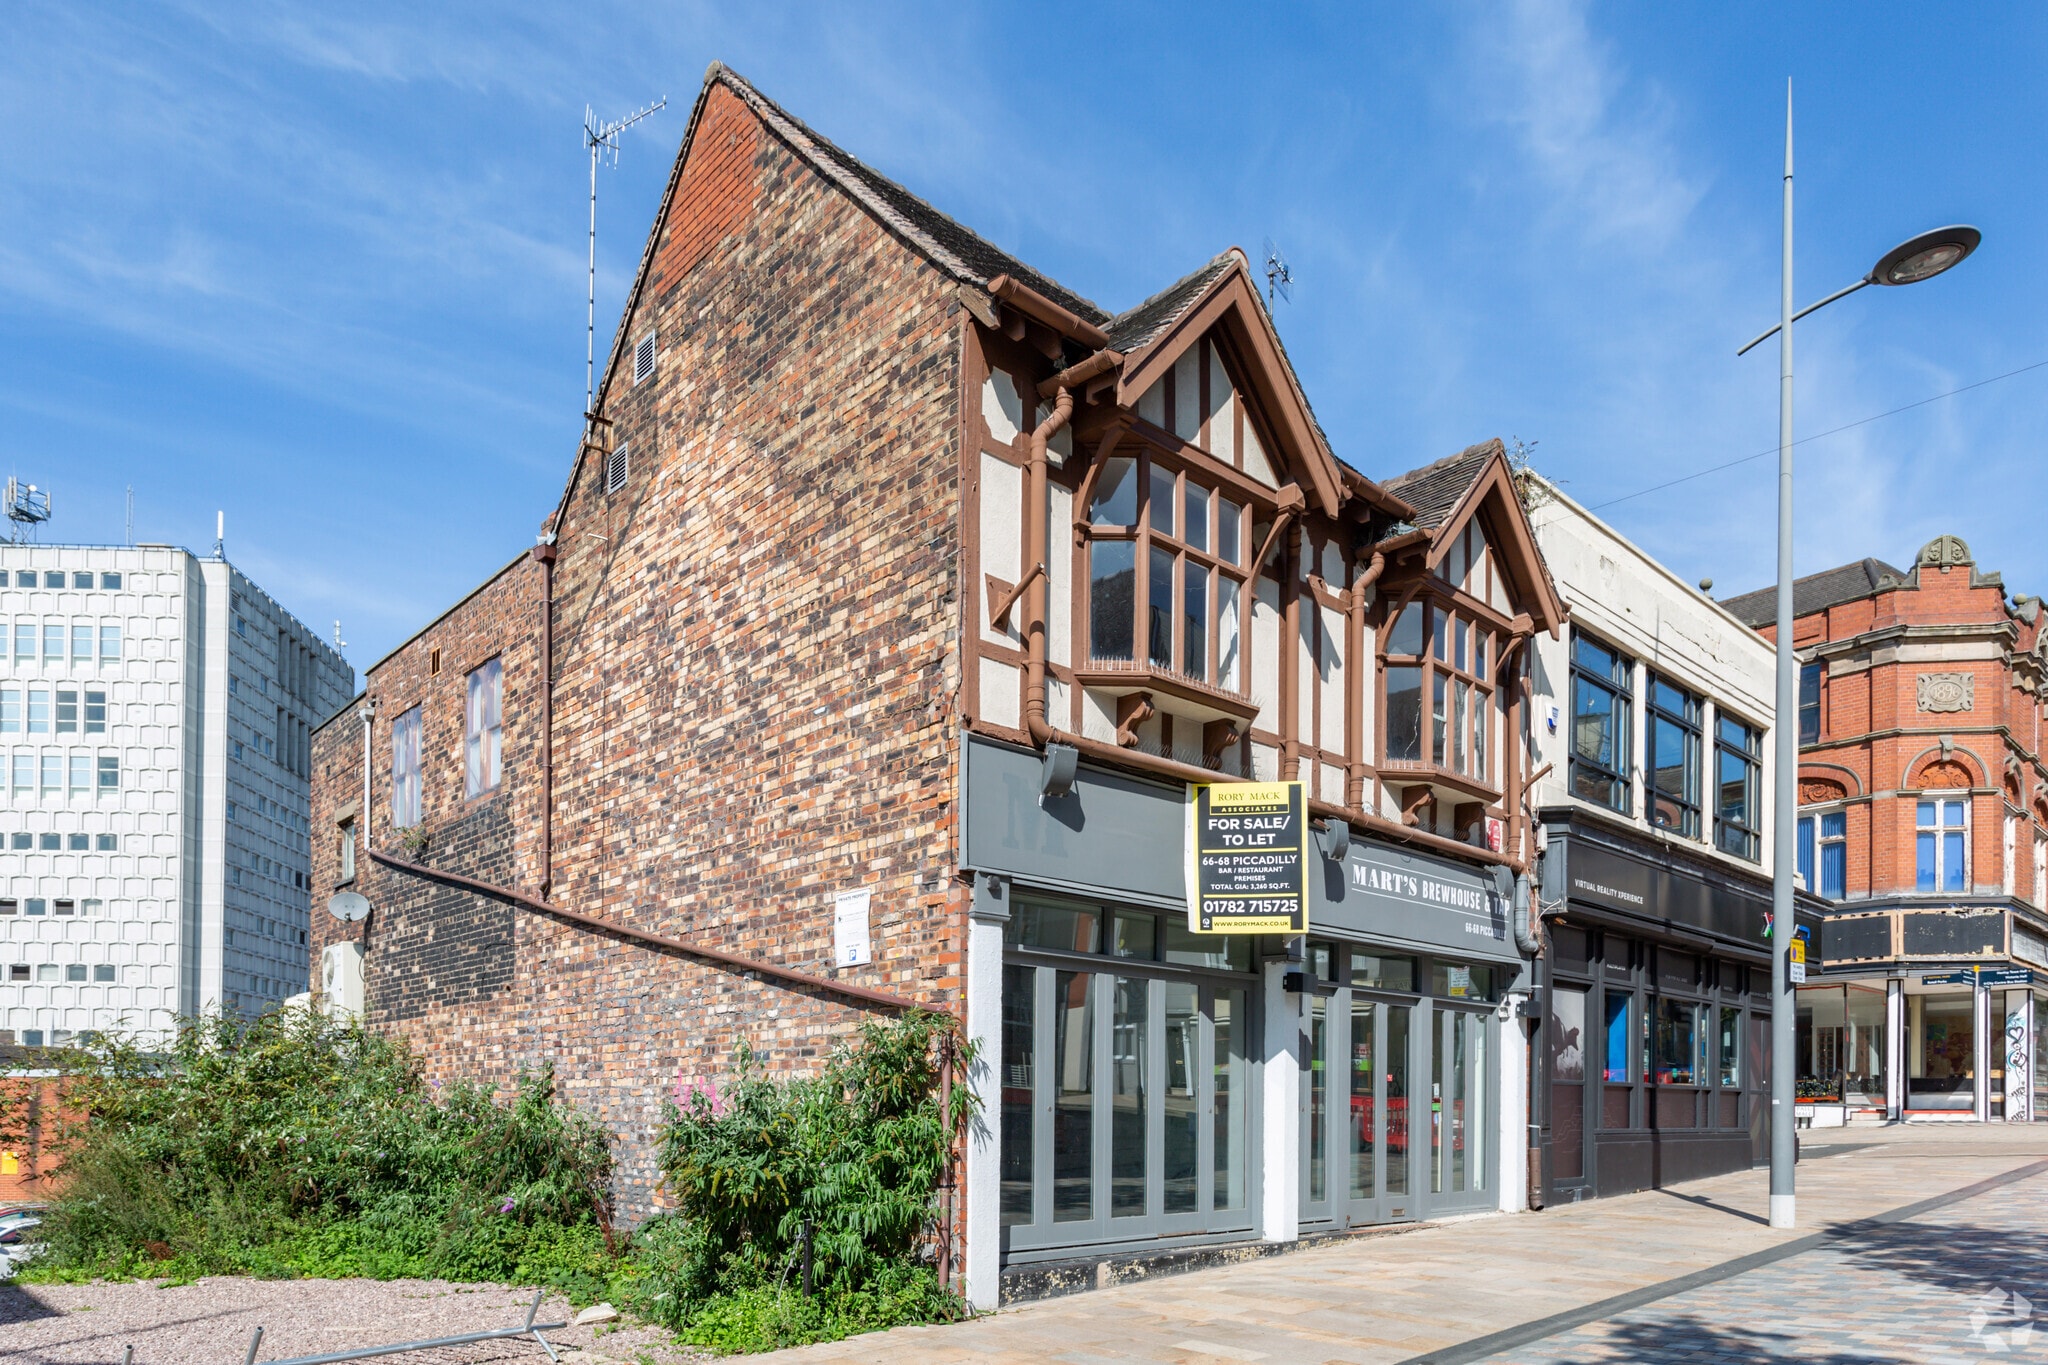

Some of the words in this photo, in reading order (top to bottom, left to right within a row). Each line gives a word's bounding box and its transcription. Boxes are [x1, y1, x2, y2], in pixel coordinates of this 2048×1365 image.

[1933, 684, 1959, 700] 1896
[1218, 792, 1245, 801] RORY
[1249, 791, 1281, 801] MACK
[1221, 805, 1277, 813] ASSOCIATES
[1208, 818, 1240, 830] FOR
[1243, 815, 1291, 830] SALE/
[1222, 834, 1245, 846] TO
[1247, 833, 1276, 846] LET
[1202, 856, 1230, 866] 66-68
[1232, 854, 1298, 866] PICCADILLY
[1268, 882, 1291, 890] SQ.FT.
[1352, 863, 1418, 897] MART'S
[1422, 880, 1481, 911] BREWHOUSE
[1484, 894, 1491, 913] &
[1493, 897, 1510, 917] TAP
[1574, 878, 1596, 892] VIRTUAL
[1596, 884, 1618, 897] REALITY
[1617, 890, 1644, 905] XPERIENCE
[1203, 900, 1246, 913] 01782
[1248, 899, 1299, 913] 715725
[1465, 922, 1480, 935] 66-68
